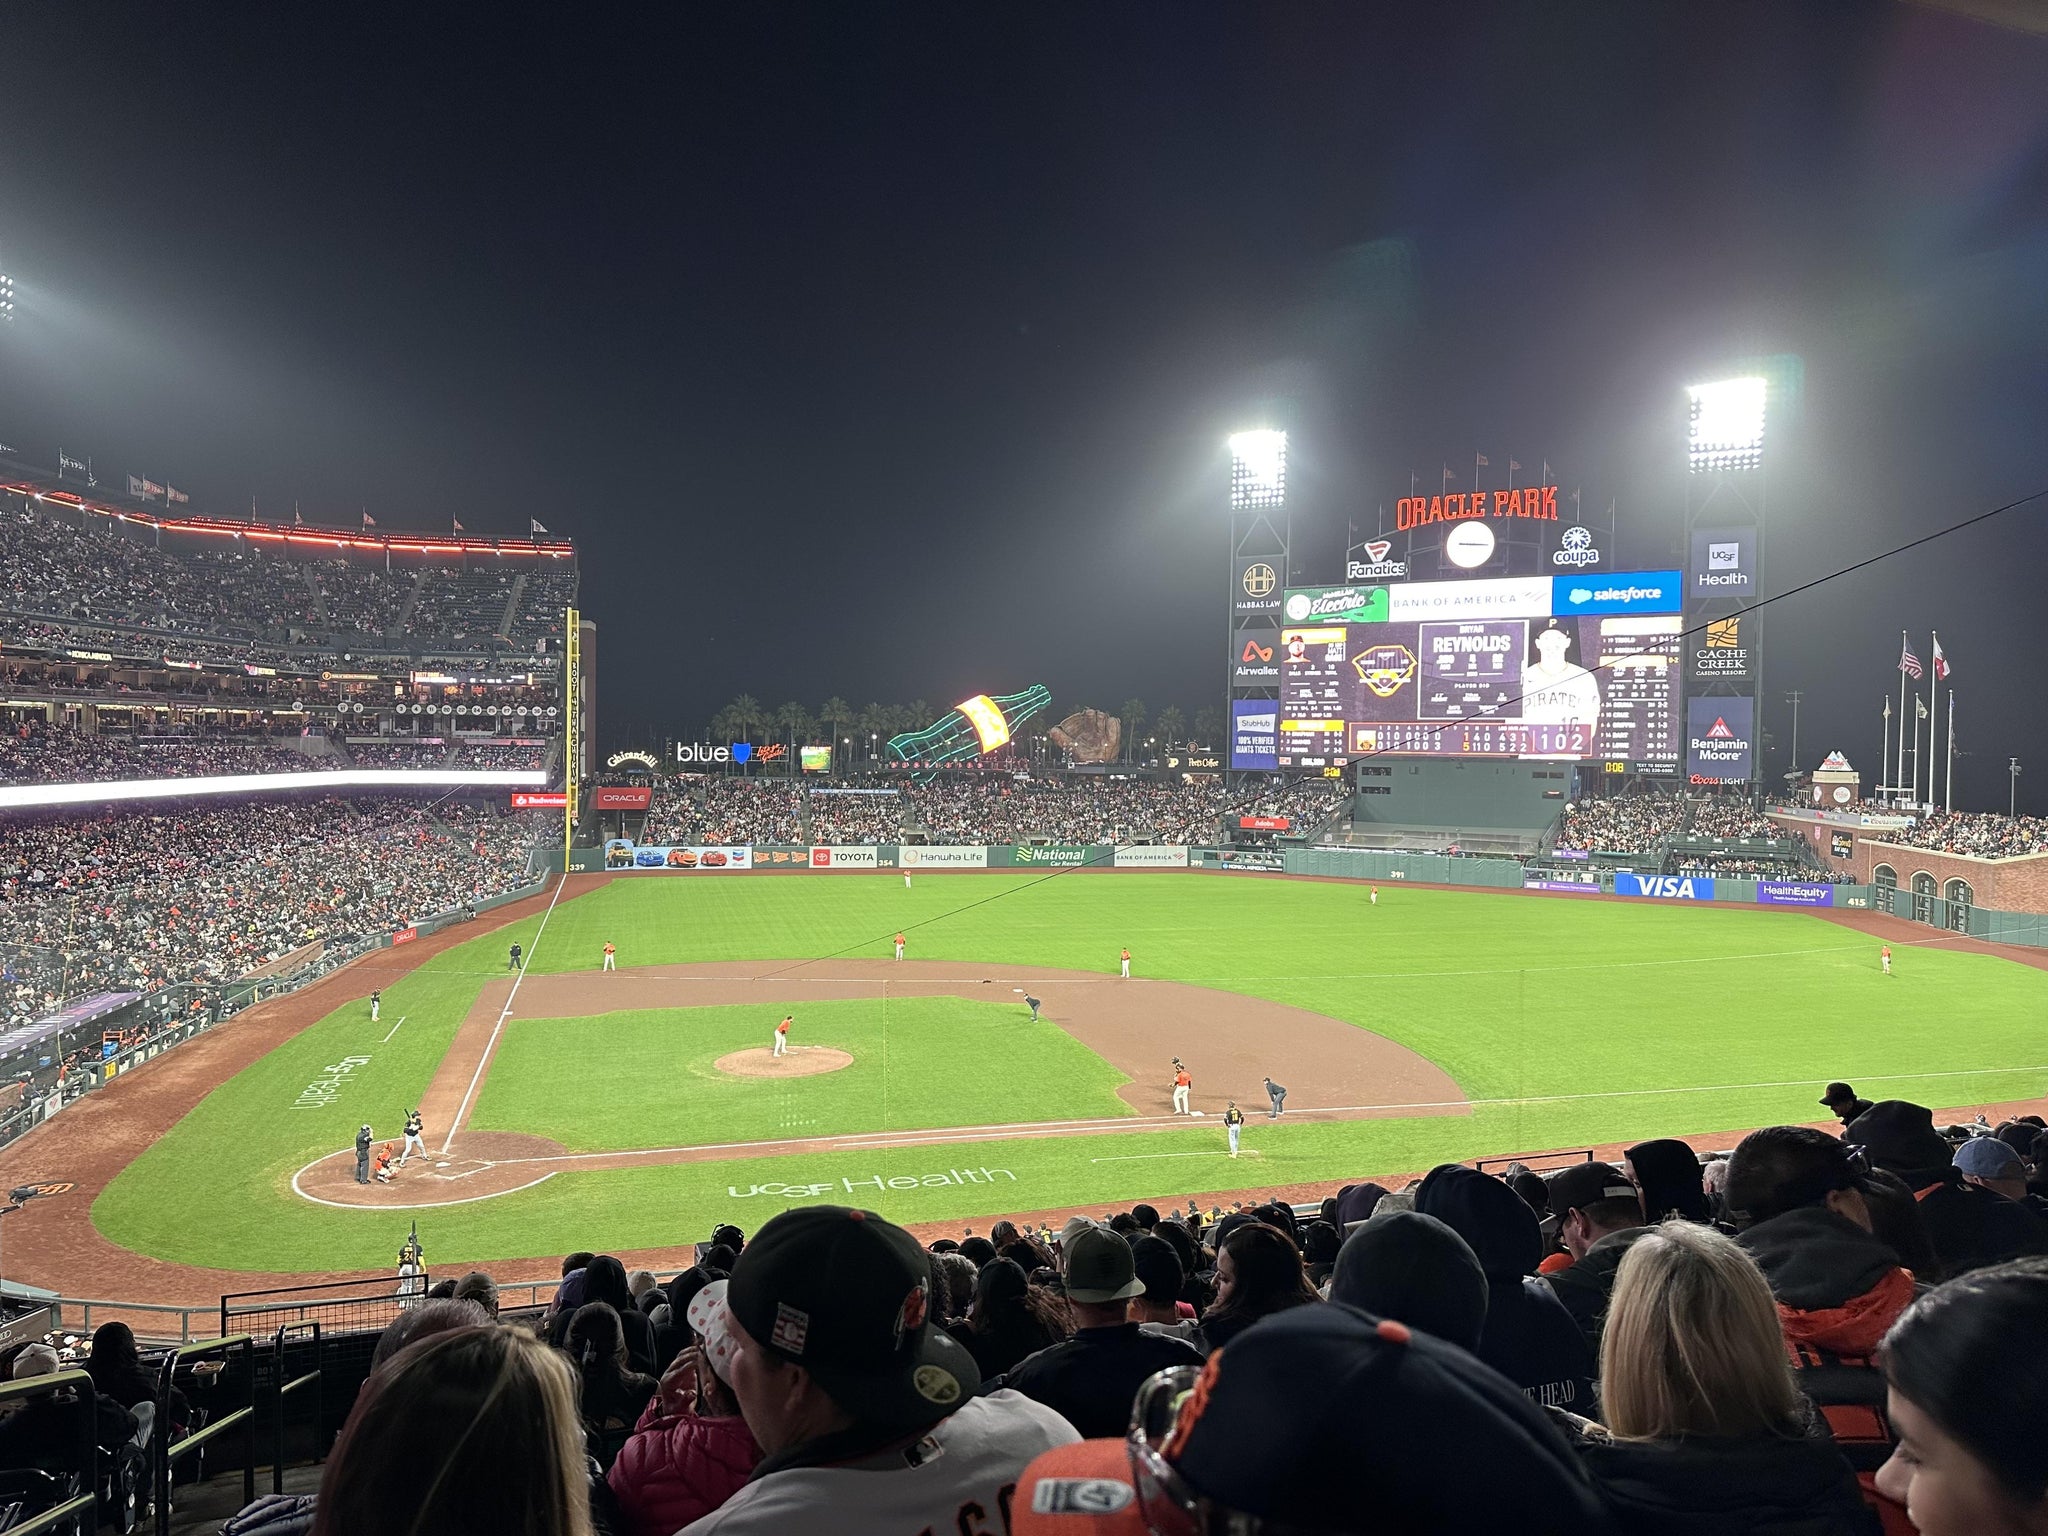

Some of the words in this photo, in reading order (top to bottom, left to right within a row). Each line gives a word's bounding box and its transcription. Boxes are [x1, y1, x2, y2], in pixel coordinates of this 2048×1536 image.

[1397, 492, 1486, 531] ORACLE
[1494, 486, 1558, 520] PARK
[1555, 550, 1598, 566] coupa
[1711, 551, 1736, 561] UCSF
[1349, 561, 1405, 577] Fanatics
[1699, 572, 1747, 585] Health
[1593, 586, 1662, 603] salesforce
[1236, 601, 1264, 609] HABBAS
[1266, 600, 1281, 608] LAW
[1393, 598, 1428, 608] BANK
[1434, 597, 1449, 606] OF
[1454, 594, 1516, 605] AMERICA
[1433, 635, 1511, 653] REYNOLDS
[1696, 649, 1747, 659] CACHE
[1697, 659, 1745, 669] CREEK
[1236, 665, 1279, 676] Airwallex
[1241, 719, 1270, 727] StubHub
[1237, 736, 1251, 745] 100%
[1252, 736, 1274, 745] VERIFIED
[1377, 732, 1383, 741] 0
[1386, 732, 1391, 741] 1
[1394, 732, 1400, 741] 0
[1406, 732, 1412, 741] 0
[1414, 732, 1420, 741] 0
[1422, 732, 1429, 741] 0
[1434, 732, 1441, 741] 0
[1464, 732, 1469, 741] 1
[1473, 732, 1480, 741] 4
[1484, 732, 1490, 741] 0
[1499, 732, 1506, 741] 4
[1509, 732, 1516, 741] 3
[1521, 732, 1526, 741] 1
[1541, 733, 1548, 750] 1
[1555, 733, 1567, 750] 0
[1571, 733, 1583, 750] 2
[1235, 745, 1254, 754] GIANTS
[1254, 745, 1276, 754] TICKETS
[1377, 742, 1383, 751] 0
[1386, 742, 1391, 751] 1
[1394, 742, 1400, 751] 0
[1406, 742, 1411, 751] 1
[1414, 742, 1420, 751] 0
[1422, 742, 1429, 751] 0
[1434, 742, 1441, 751] 3
[1463, 742, 1470, 751] 5
[1472, 742, 1481, 751] 11
[1484, 742, 1490, 751] 0
[1499, 742, 1506, 751] 5
[1509, 742, 1516, 751] 2
[1520, 742, 1527, 751] 2
[1691, 738, 1748, 751] Benjamin
[677, 741, 729, 762] blue
[1699, 749, 1739, 761] Moore
[607, 750, 658, 768] Ghirardelli
[1202, 758, 1219, 768] Coffee
[1605, 762, 1624, 773] 0:08
[1690, 773, 1719, 785] Coors
[1720, 777, 1745, 785] LIGHT
[528, 796, 567, 805] Budweiser
[834, 853, 874, 861] TOYOTA
[920, 853, 961, 861] Hanwha
[963, 853, 983, 861] Life
[1033, 848, 1083, 860] National
[1390, 870, 1405, 879] 391
[1633, 875, 1696, 899] VISA
[1763, 884, 1826, 899] HealthEquity
[1847, 897, 1866, 907] 415
[728, 1182, 834, 1198] UCSF
[841, 1166, 1018, 1193] Health
[1540, 1379, 1575, 1406] HEAD
